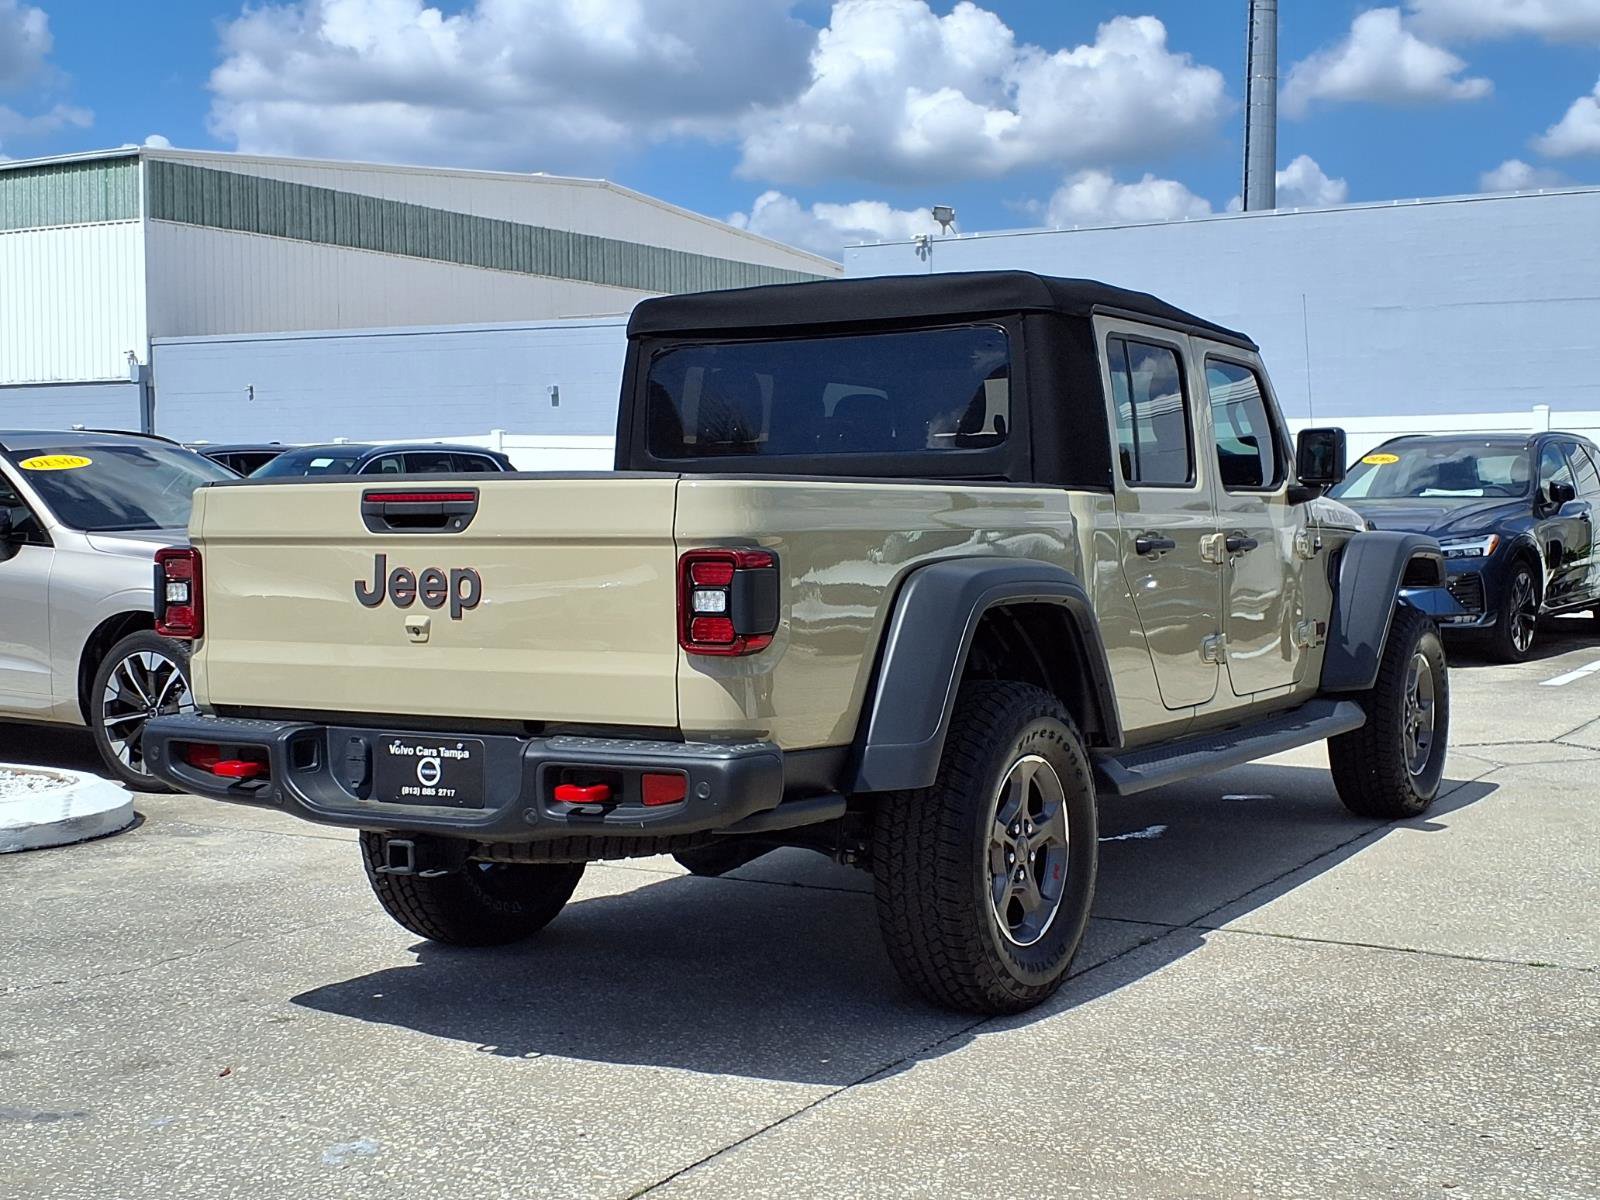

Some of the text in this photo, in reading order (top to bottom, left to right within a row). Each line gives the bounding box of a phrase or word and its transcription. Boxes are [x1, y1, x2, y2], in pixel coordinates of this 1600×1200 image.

[29, 457, 84, 468] DEMO
[354, 553, 482, 620] Jeep
[389, 744, 470, 760] Volvo Cars Tampa
[401, 786, 420, 796] (813)
[437, 788, 456, 797] 2717
